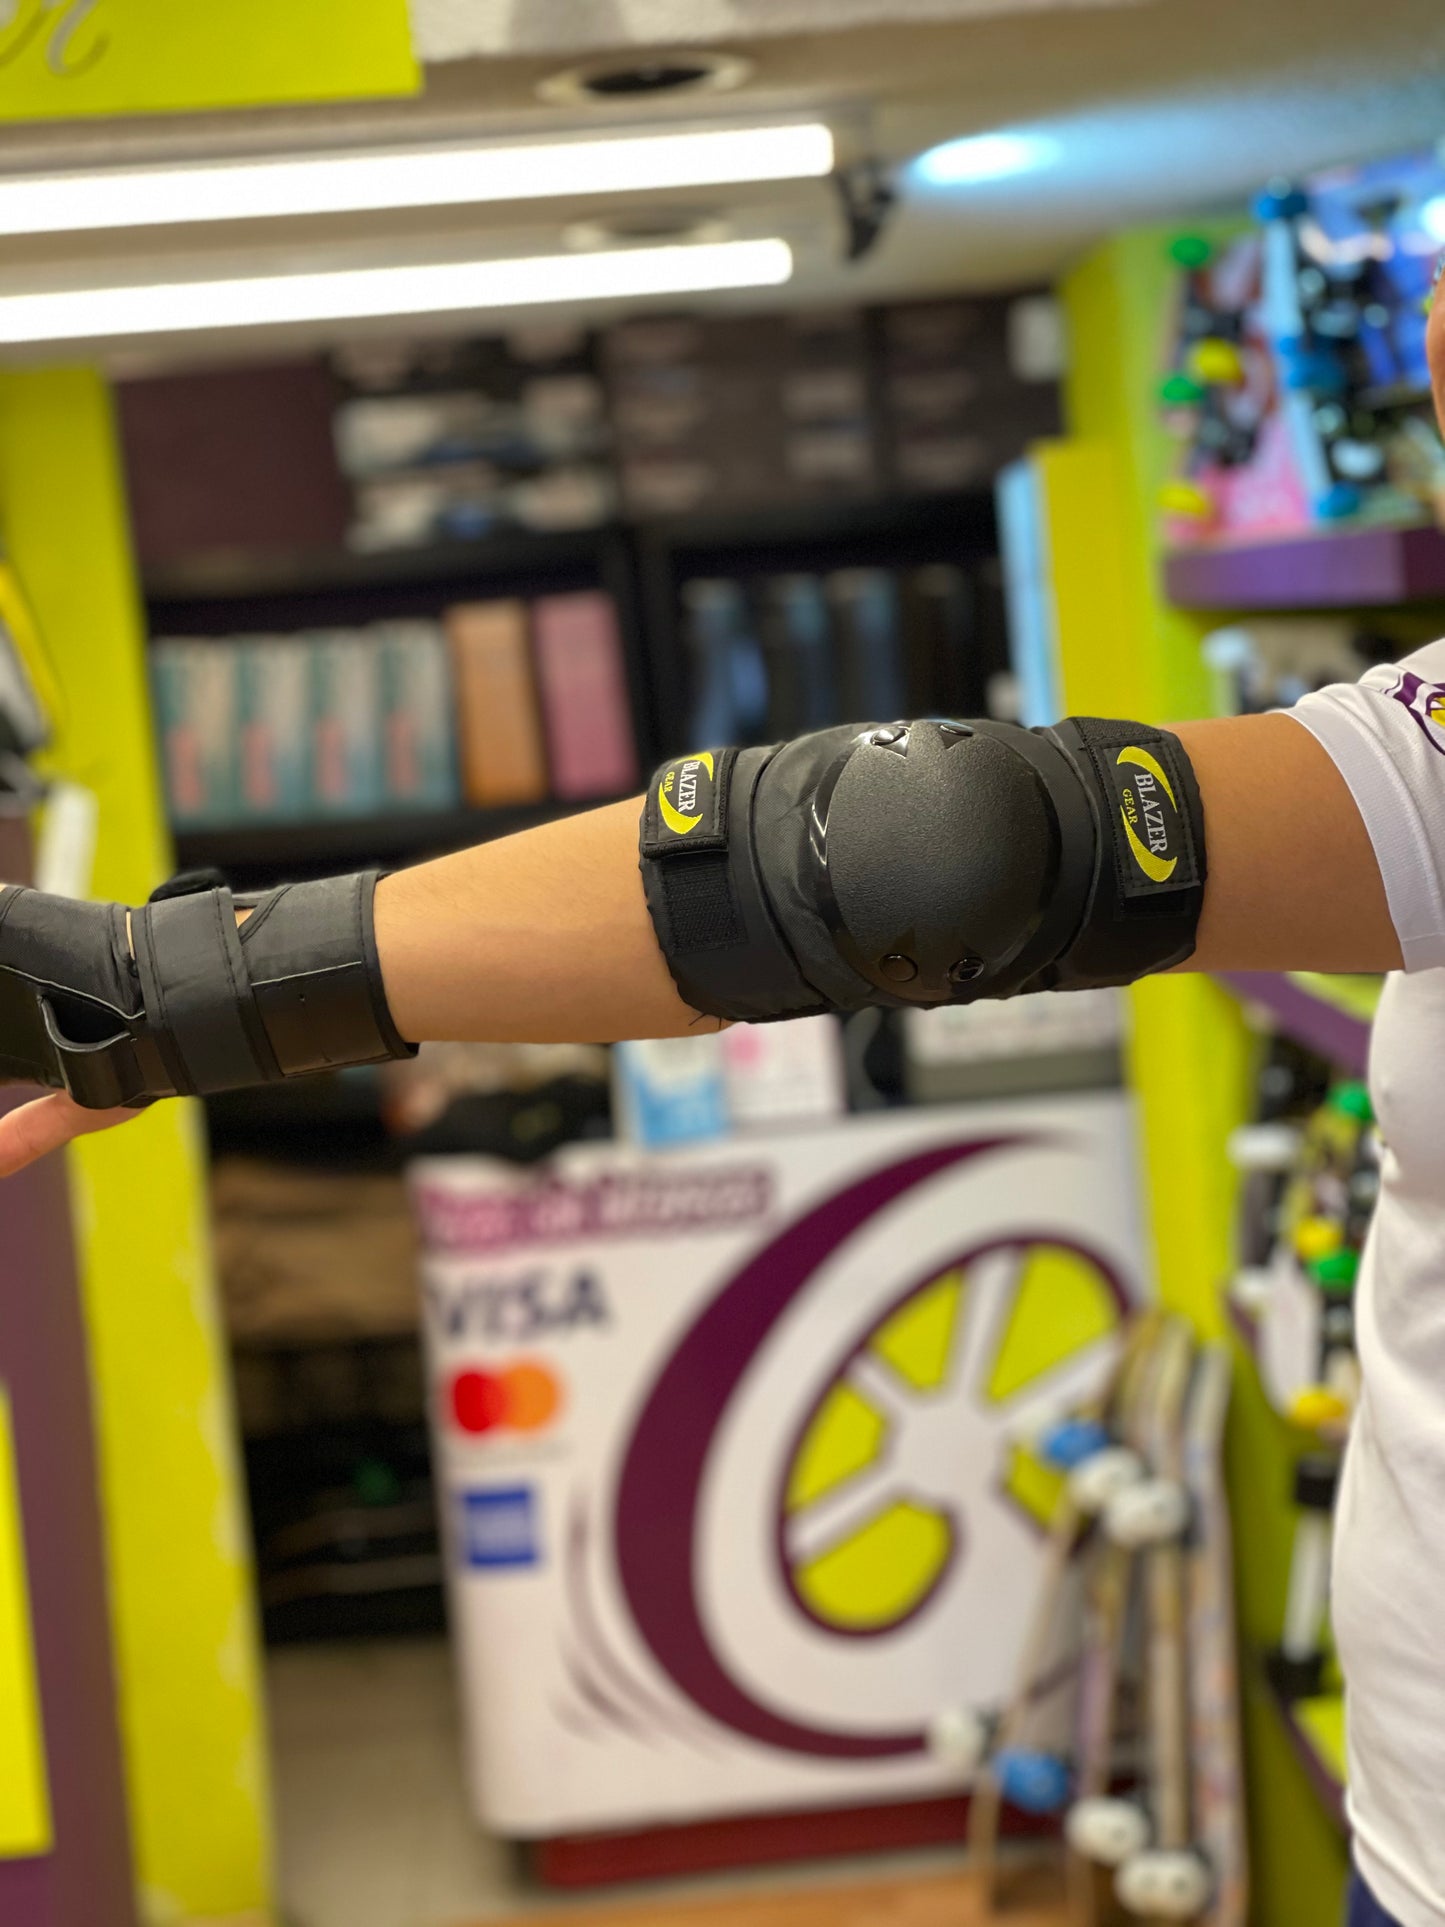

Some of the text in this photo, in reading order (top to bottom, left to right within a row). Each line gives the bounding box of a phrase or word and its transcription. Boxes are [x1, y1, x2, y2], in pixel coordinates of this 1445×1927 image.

[664, 771, 675, 793] GEAR
[678, 761, 700, 812] BLAZER
[1122, 788, 1138, 824] GEAR
[1134, 773, 1168, 853] BLAZER
[432, 1266, 609, 1340] VISA
